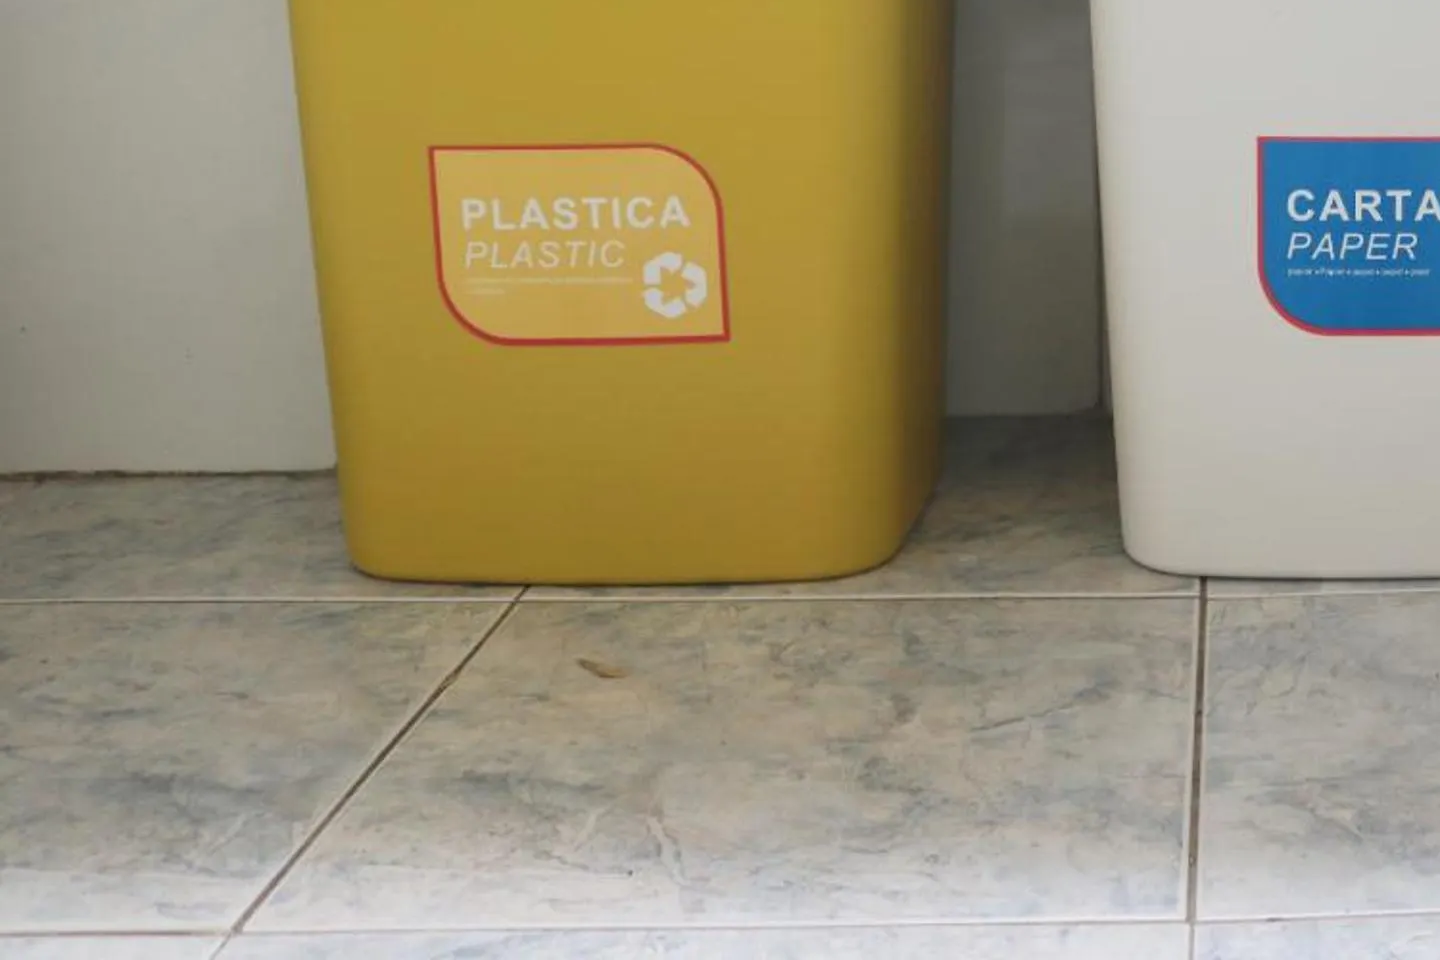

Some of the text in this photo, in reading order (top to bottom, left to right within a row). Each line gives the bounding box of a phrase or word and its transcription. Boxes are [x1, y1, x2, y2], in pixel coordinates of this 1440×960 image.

[460, 194, 691, 230] PLASTICA
[464, 239, 626, 269] PLASTIC
[1286, 232, 1419, 261] PAPER
